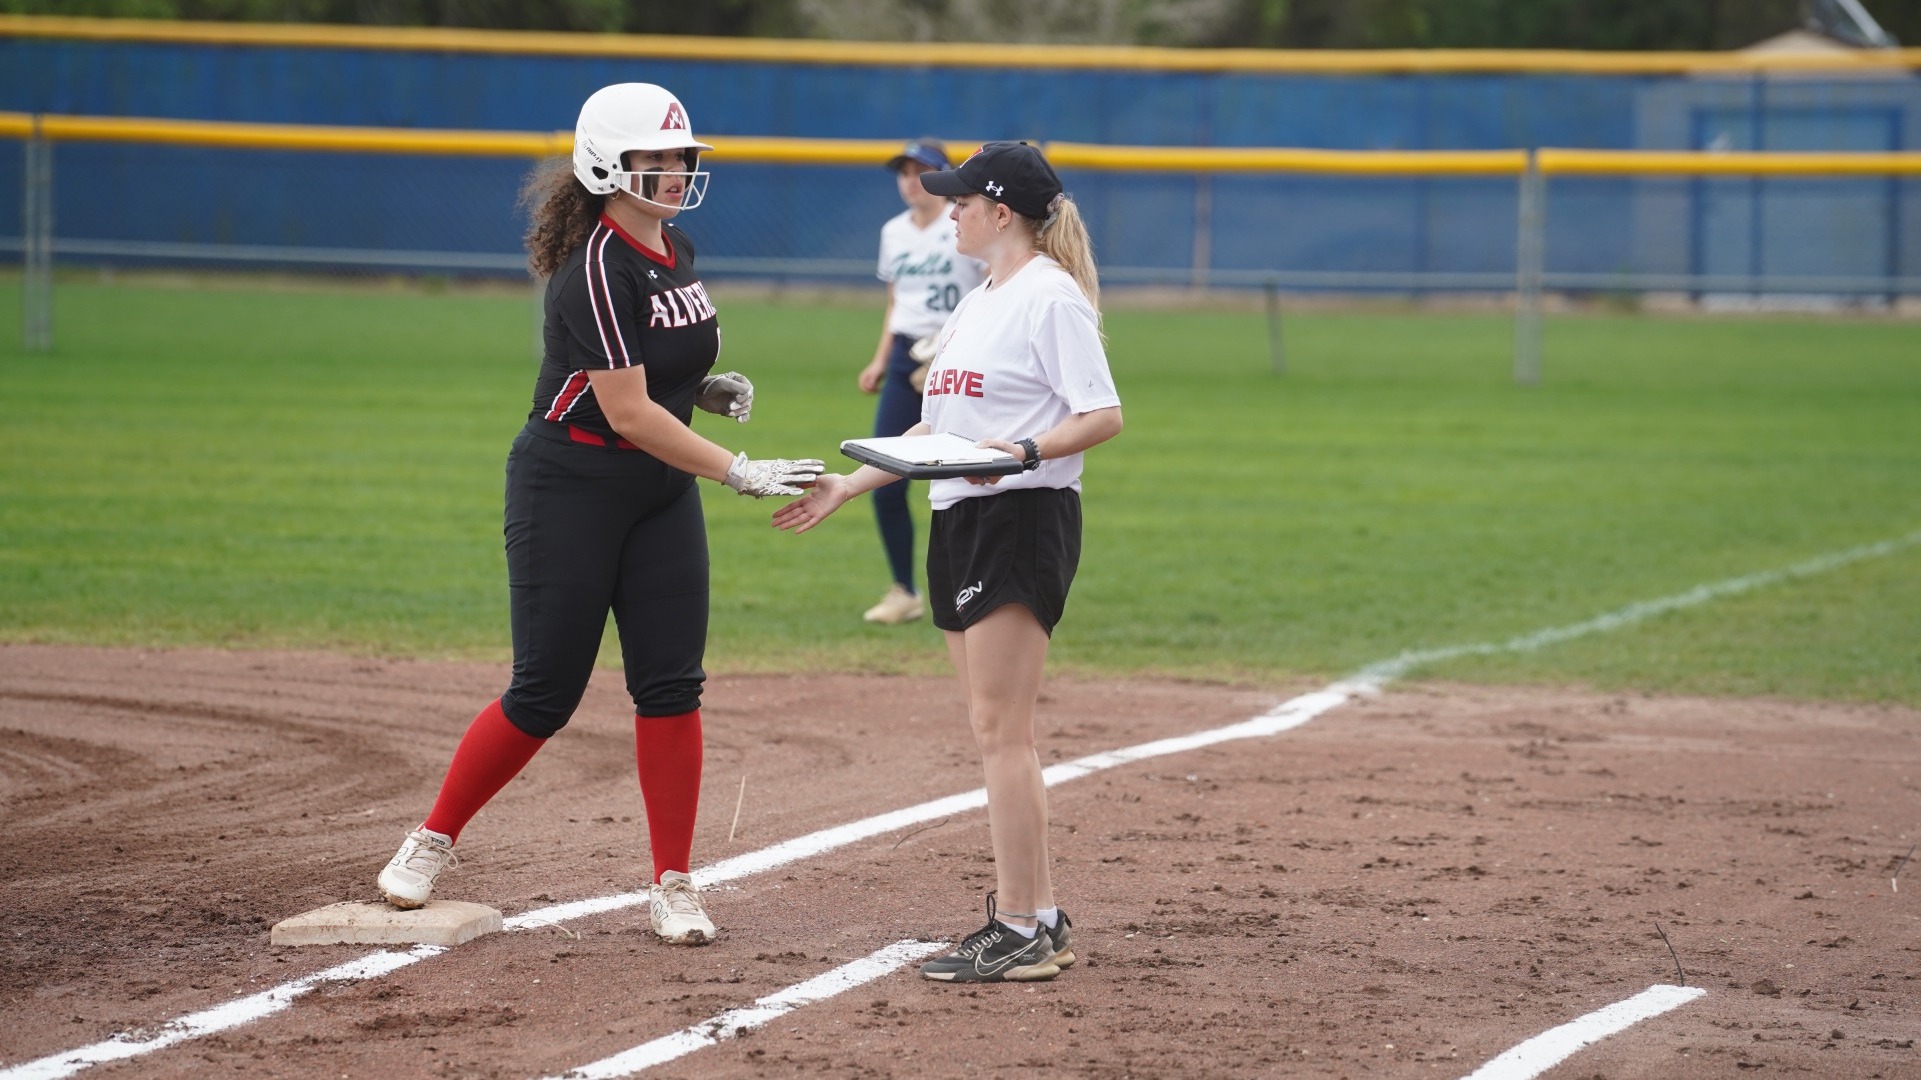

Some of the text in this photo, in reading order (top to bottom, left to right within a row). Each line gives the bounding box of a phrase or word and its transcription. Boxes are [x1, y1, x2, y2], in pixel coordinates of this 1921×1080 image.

[649, 280, 717, 329] ALVER
[925, 283, 960, 312] 20
[927, 368, 985, 398] ELIEVE
